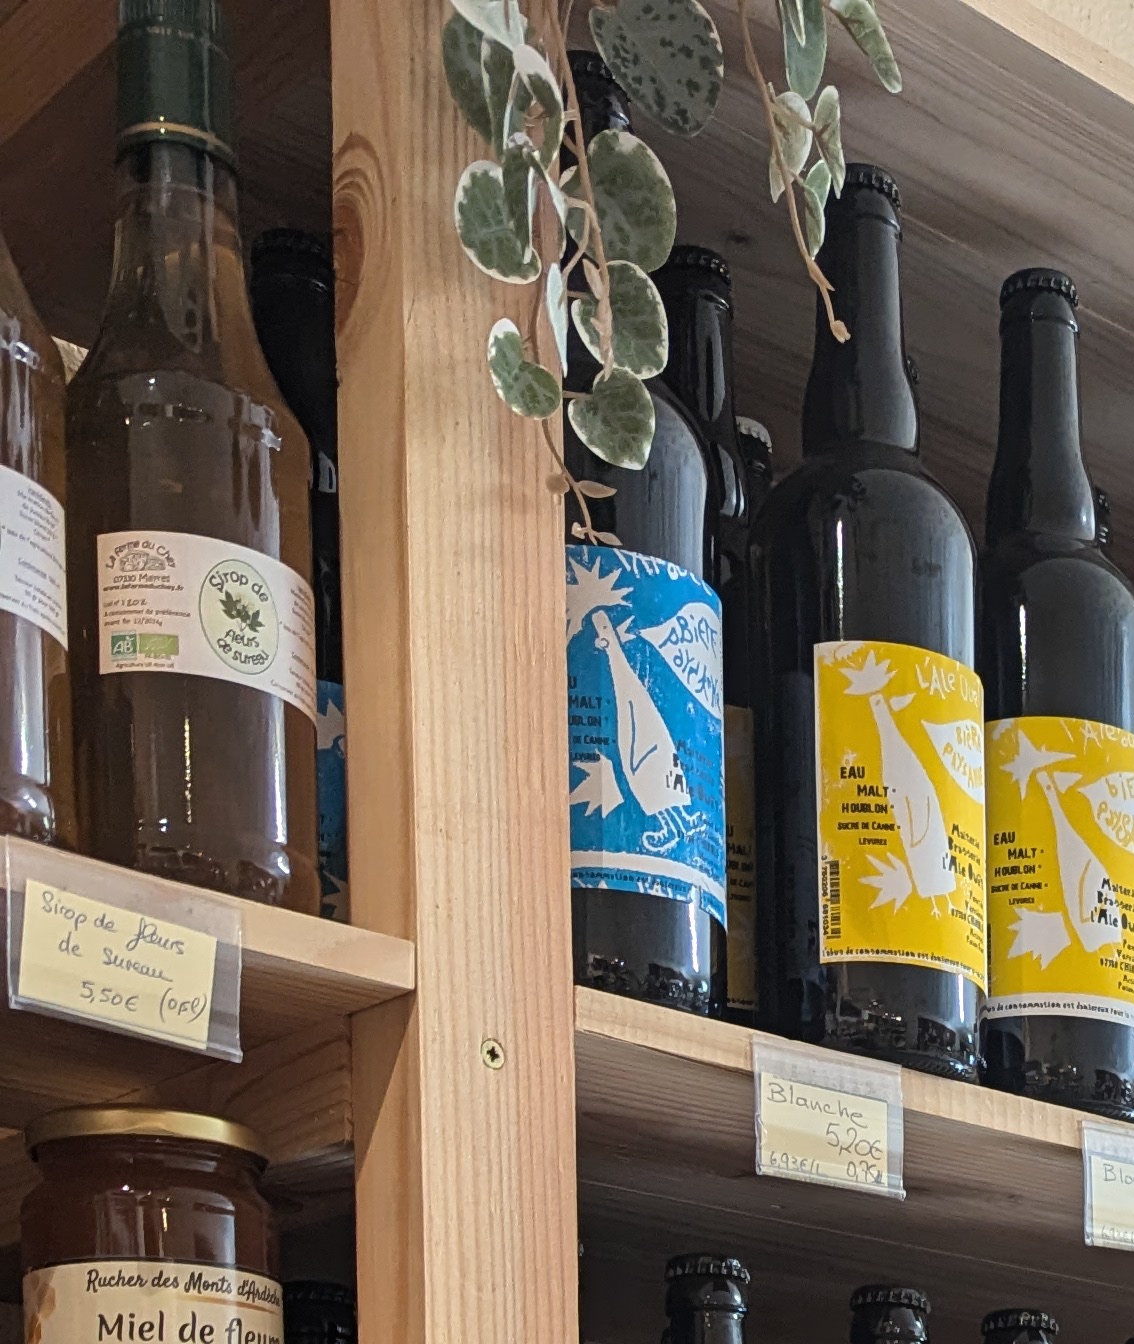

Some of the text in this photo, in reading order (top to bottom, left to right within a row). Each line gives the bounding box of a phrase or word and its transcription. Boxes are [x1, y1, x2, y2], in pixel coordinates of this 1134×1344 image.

[251, 582, 269, 604] de
[840, 766, 866, 780] EAU
[857, 784, 889, 798] MALT
[841, 802, 888, 814] HOUBLON
[993, 832, 1015, 845] EAU
[1008, 848, 1037, 860] MALT
[995, 865, 1036, 877] HOUBLON
[42, 891, 185, 955] Sirop de fleurs
[59, 932, 82, 957] de
[80, 981, 139, 1012] 5,50€
[767, 1082, 868, 1129] Blanche
[826, 1122, 883, 1160] 5,20€
[86, 1269, 232, 1294] Rucher des Monts
[97, 1311, 164, 1343] Miel
[178, 1313, 215, 1344] de
